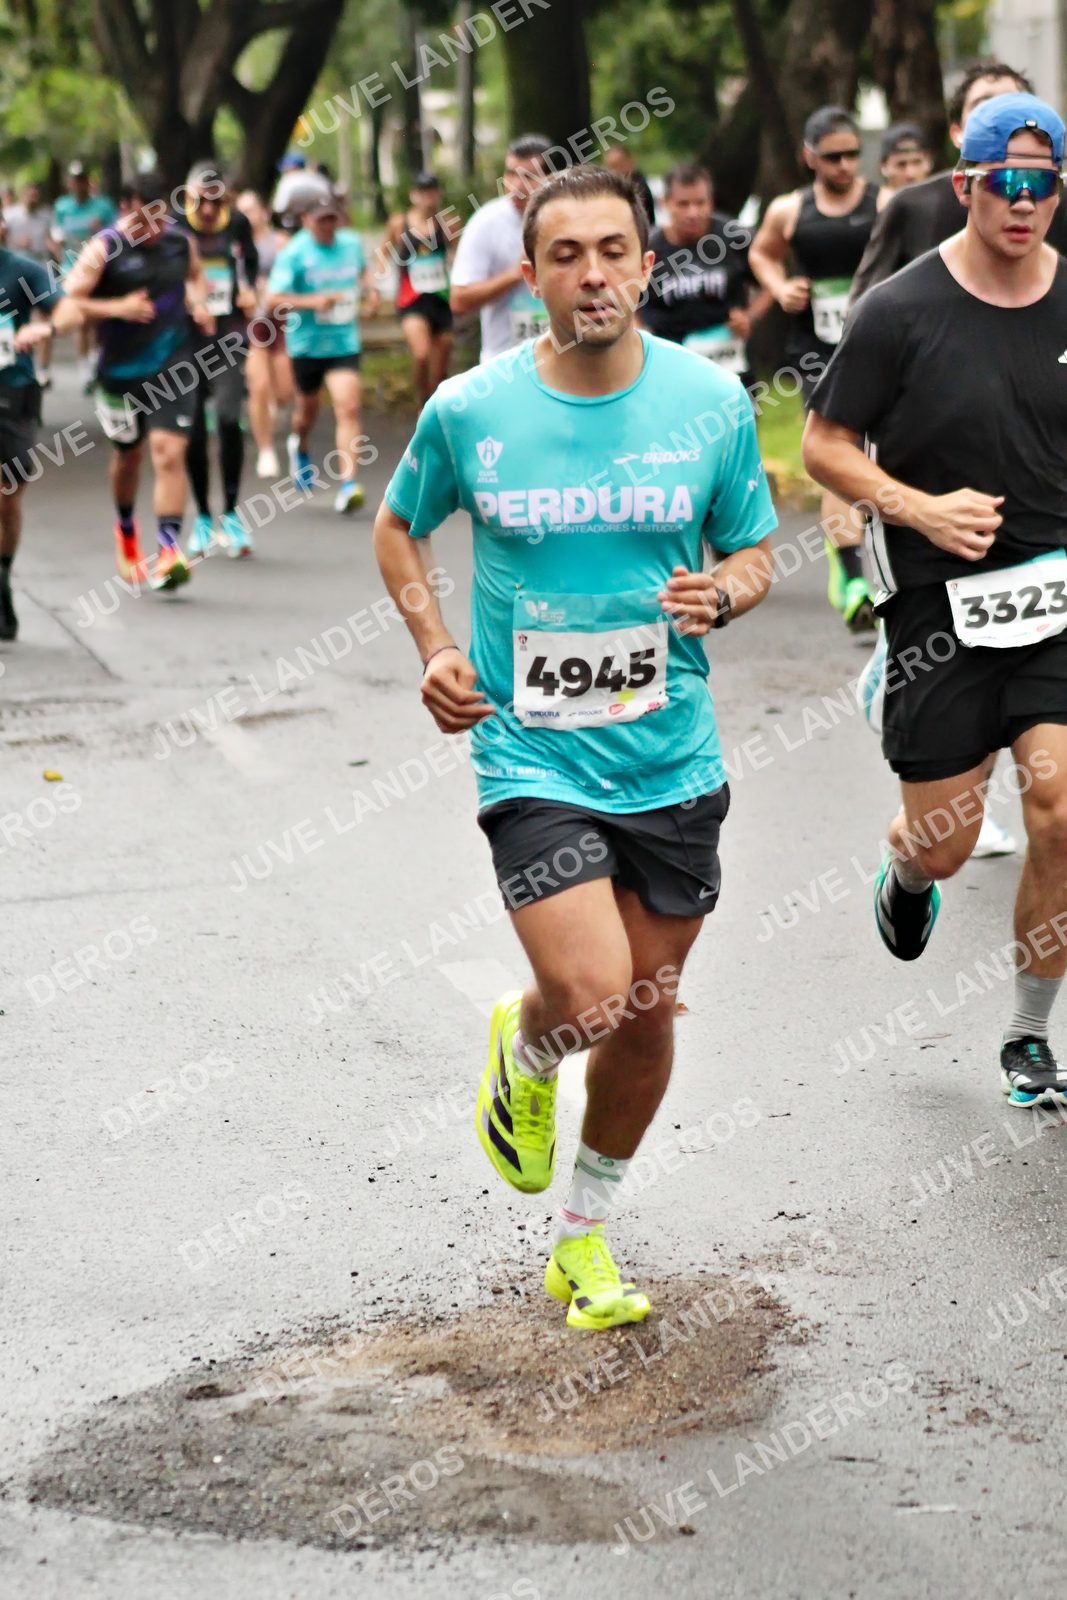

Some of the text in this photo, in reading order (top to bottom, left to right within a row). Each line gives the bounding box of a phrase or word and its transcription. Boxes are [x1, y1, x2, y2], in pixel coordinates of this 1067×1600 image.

[641, 449, 701, 465] BROOKS
[474, 485, 693, 528] PERDURA
[960, 581, 1067, 629] 3323
[526, 648, 657, 697] 4945
